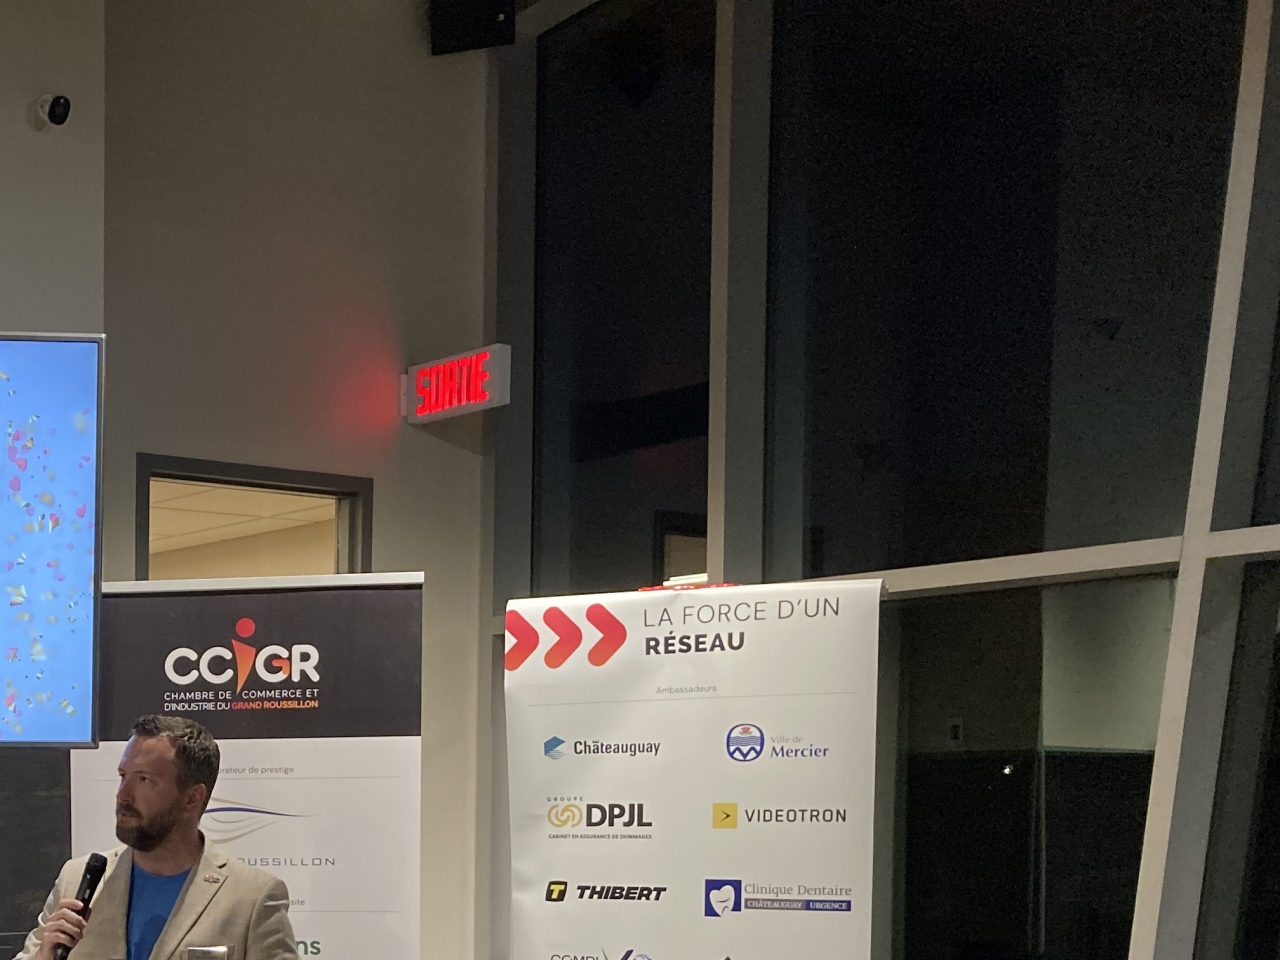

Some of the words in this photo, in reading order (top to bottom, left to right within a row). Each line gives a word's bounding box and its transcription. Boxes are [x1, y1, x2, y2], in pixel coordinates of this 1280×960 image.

[416, 351, 490, 416] SORTIE
[643, 608, 673, 628] LA
[682, 601, 767, 625] FORCE
[777, 597, 840, 620] D'UN
[645, 631, 746, 656] RÉSEAU
[164, 617, 320, 695] CCIGR
[164, 691, 215, 700] CHAMBRE
[218, 691, 232, 700] DE
[242, 689, 303, 699] COMMERCE
[306, 688, 319, 697] ET
[656, 684, 717, 695] Ambassadeurs
[164, 702, 216, 711] D'INDUSTRIE
[217, 701, 230, 710] DU
[232, 700, 262, 710] GRAND
[263, 700, 319, 709] ROUSSILLON
[770, 735, 792, 744] Ville
[794, 734, 803, 744] de
[573, 739, 661, 758] Châteauguay
[770, 744, 829, 759] Mercier
[248, 766, 259, 774] de
[261, 766, 294, 775] prestige
[586, 803, 652, 828] DPJL
[745, 808, 847, 823] VIDEOTRON
[237, 858, 336, 866] USSILLON
[576, 885, 667, 901] THIBERT
[744, 883, 793, 897] Clinique
[798, 884, 852, 897] Dentaire
[747, 899, 802, 909] CHÂTEAUGUAY
[810, 901, 847, 910] URGENCE
